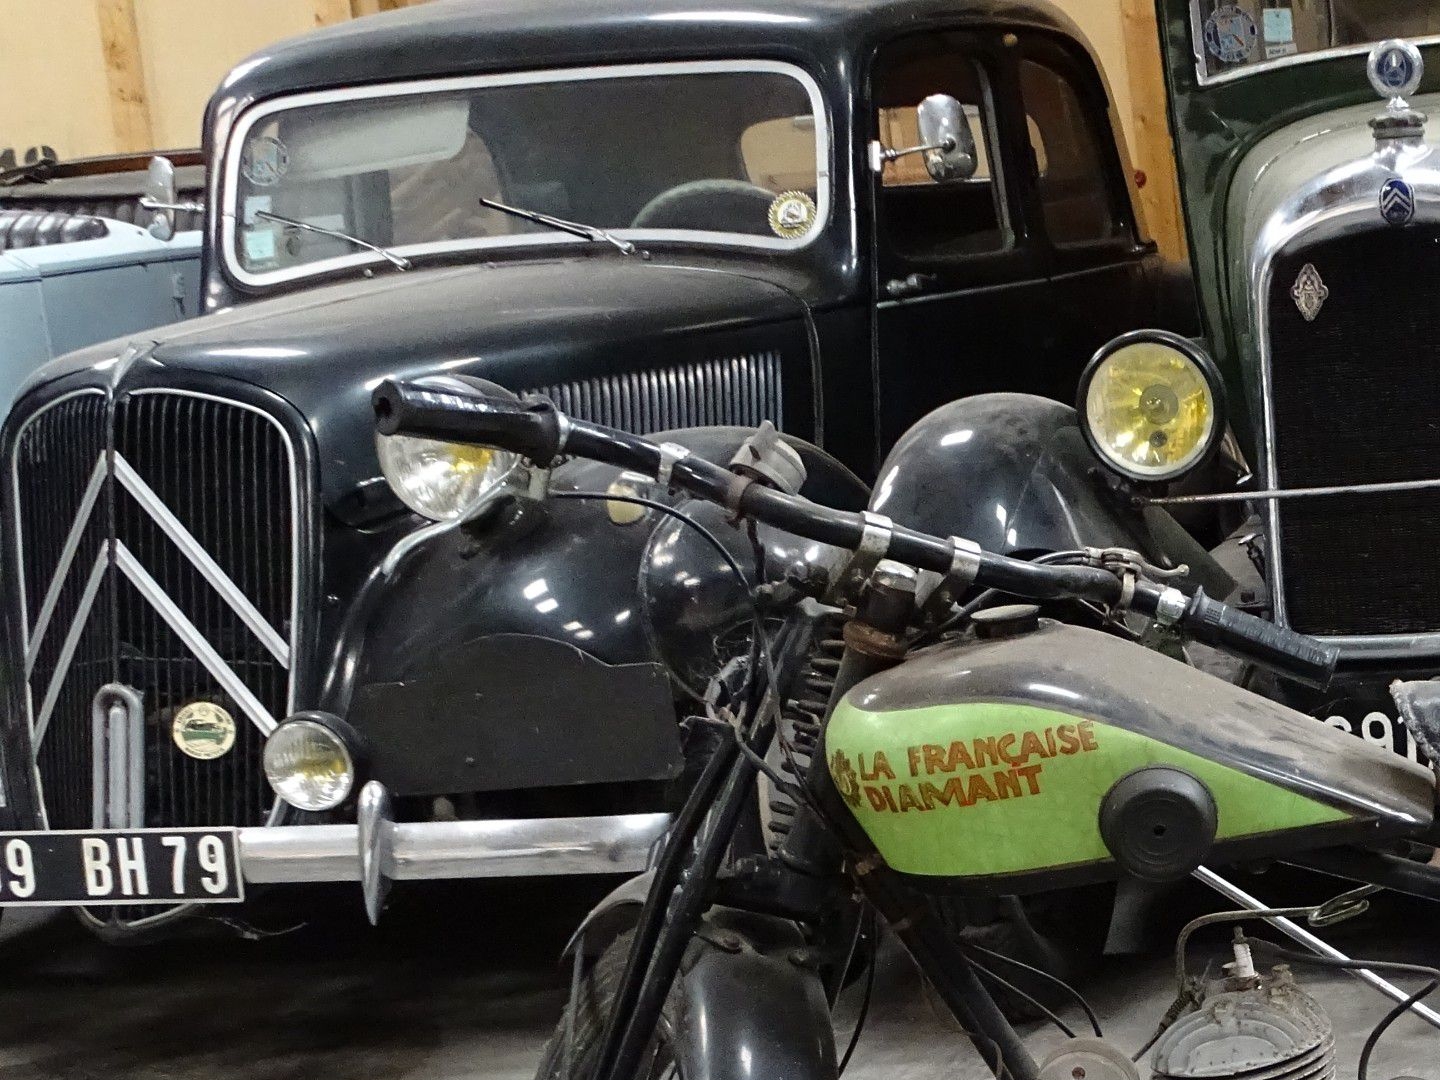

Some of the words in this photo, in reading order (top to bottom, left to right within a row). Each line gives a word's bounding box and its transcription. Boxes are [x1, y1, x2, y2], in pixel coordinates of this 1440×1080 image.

[858, 751, 896, 781] LA
[907, 719, 1099, 777] FRANÇAISE
[864, 764, 1042, 813] DIAMANT
[0, 838, 36, 898] 9
[82, 837, 149, 897] BH
[162, 835, 228, 894] 79
